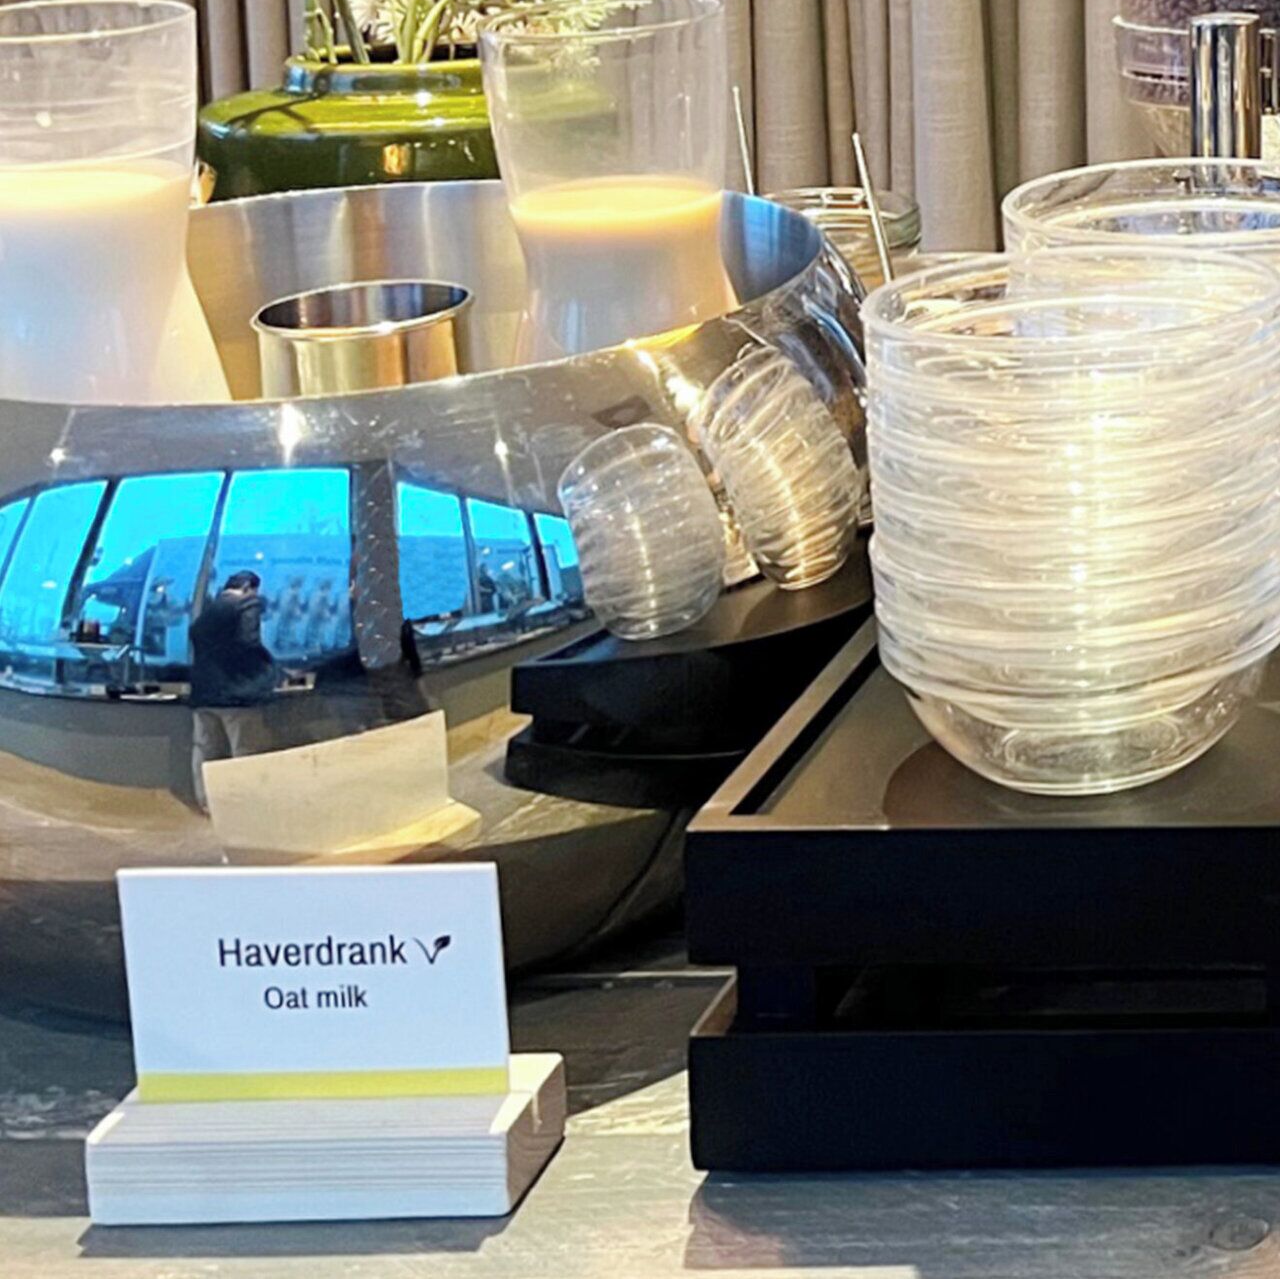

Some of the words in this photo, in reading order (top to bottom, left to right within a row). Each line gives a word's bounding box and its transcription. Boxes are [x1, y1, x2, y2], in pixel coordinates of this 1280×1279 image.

[218, 933, 408, 968] Haverdrank
[263, 986, 309, 1010] Oat
[316, 984, 368, 1009] milk
